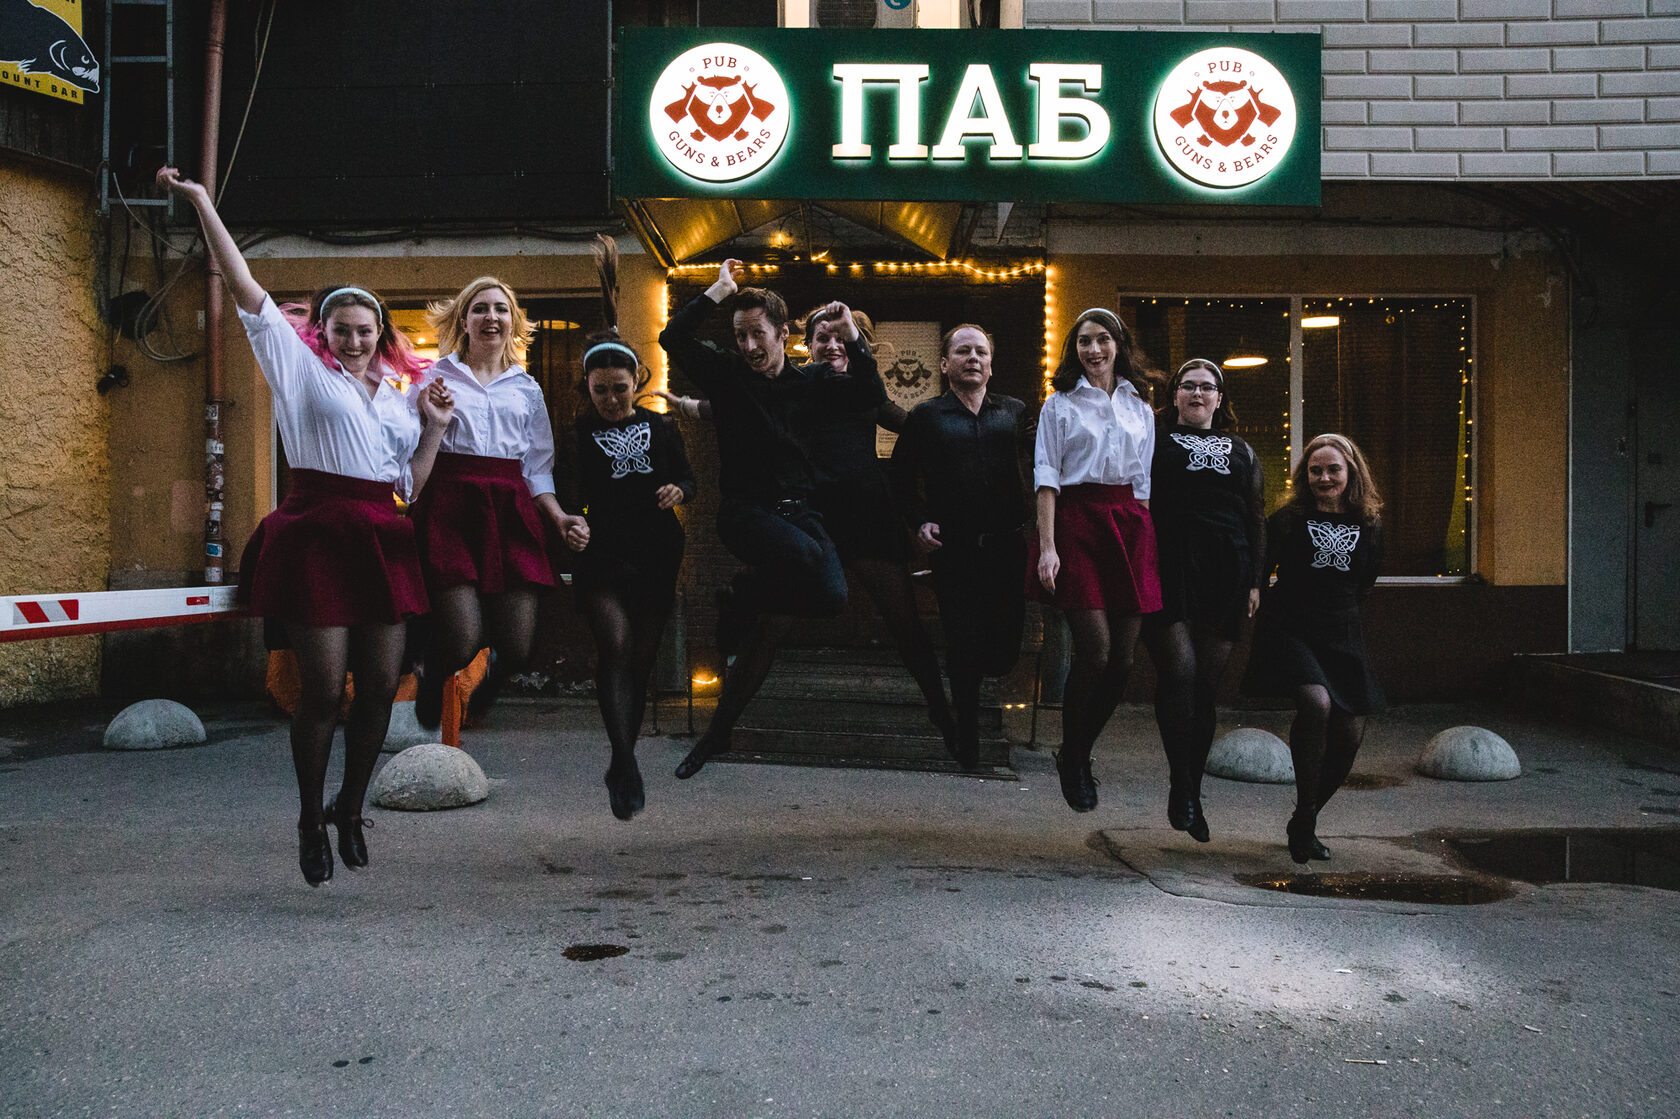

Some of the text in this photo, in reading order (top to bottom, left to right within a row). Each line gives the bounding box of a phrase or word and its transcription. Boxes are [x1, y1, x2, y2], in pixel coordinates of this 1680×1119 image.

[702, 56, 737, 69] PUB
[1208, 61, 1242, 73] PUB
[51, 84, 78, 99] BAR
[832, 63, 1111, 160] ПАБ
[668, 129, 771, 167] GUNS & BEARS
[1175, 134, 1278, 173] GUNS & BEARS
